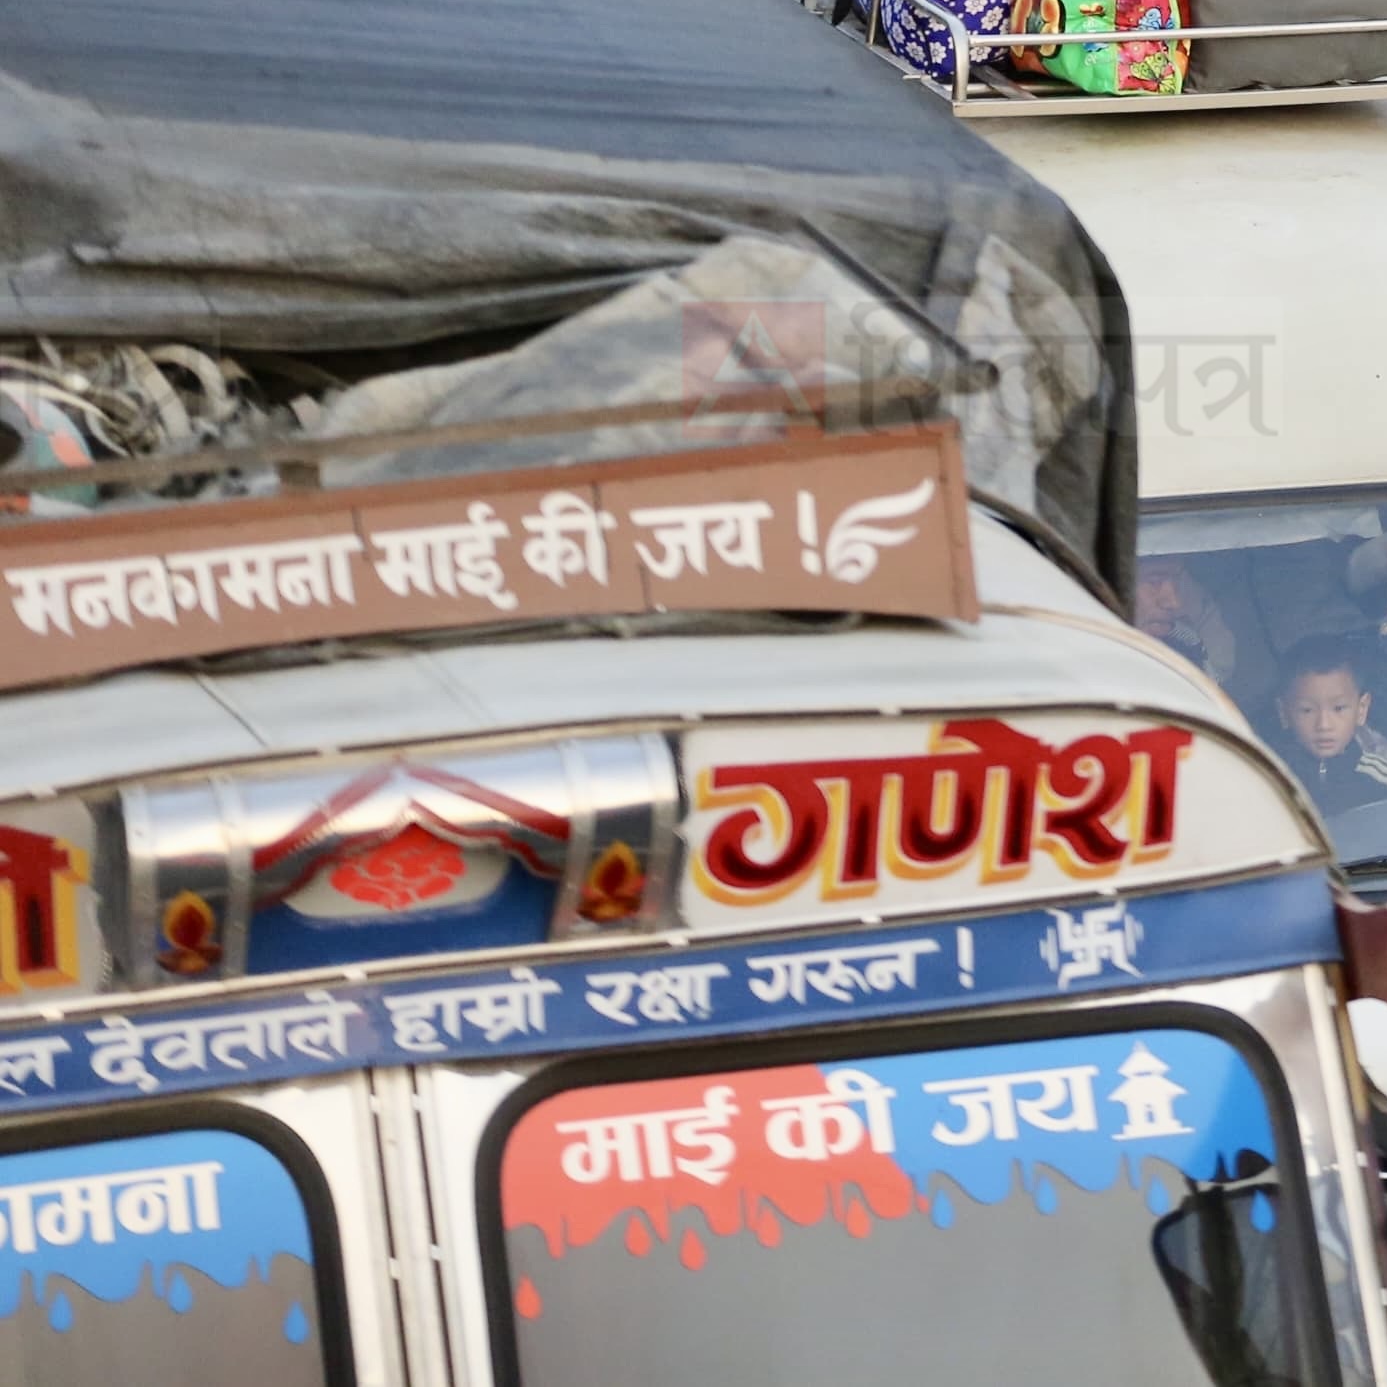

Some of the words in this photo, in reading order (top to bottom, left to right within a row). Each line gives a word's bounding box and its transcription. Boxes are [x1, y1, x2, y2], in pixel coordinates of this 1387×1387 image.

[5, 534, 363, 638] मनकामना
[370, 500, 513, 609] माई
[521, 489, 612, 587] की
[630, 501, 776, 580] जय
[694, 718, 1194, 906] गणेश
[90, 996, 361, 1093] देवताले
[585, 959, 732, 1023] रक्षा
[748, 937, 942, 998] गरून
[556, 1086, 738, 1185] माई
[762, 1067, 897, 1160] की
[920, 1062, 1100, 1147] जय
